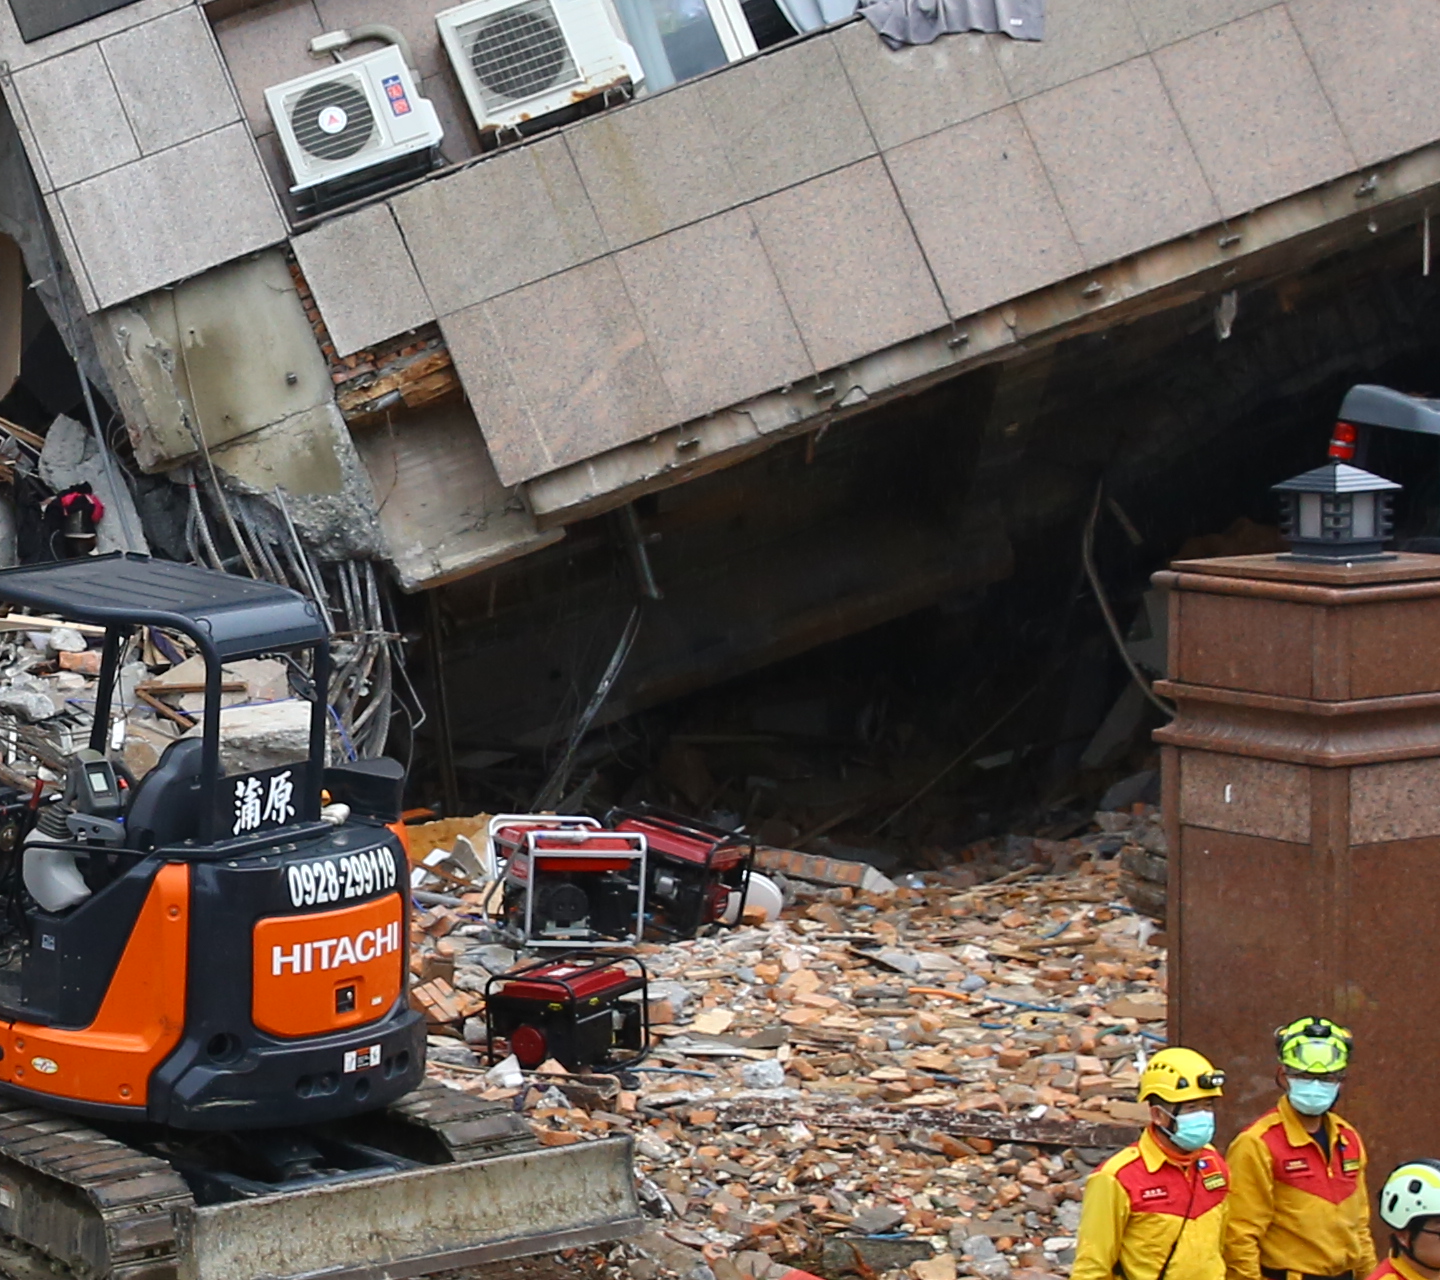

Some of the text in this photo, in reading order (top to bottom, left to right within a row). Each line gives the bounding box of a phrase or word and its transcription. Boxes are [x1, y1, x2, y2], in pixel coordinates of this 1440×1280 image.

[232, 770, 295, 836] 蒲原
[288, 846, 397, 908] 0928-299119
[271, 921, 400, 976] HITACHI
